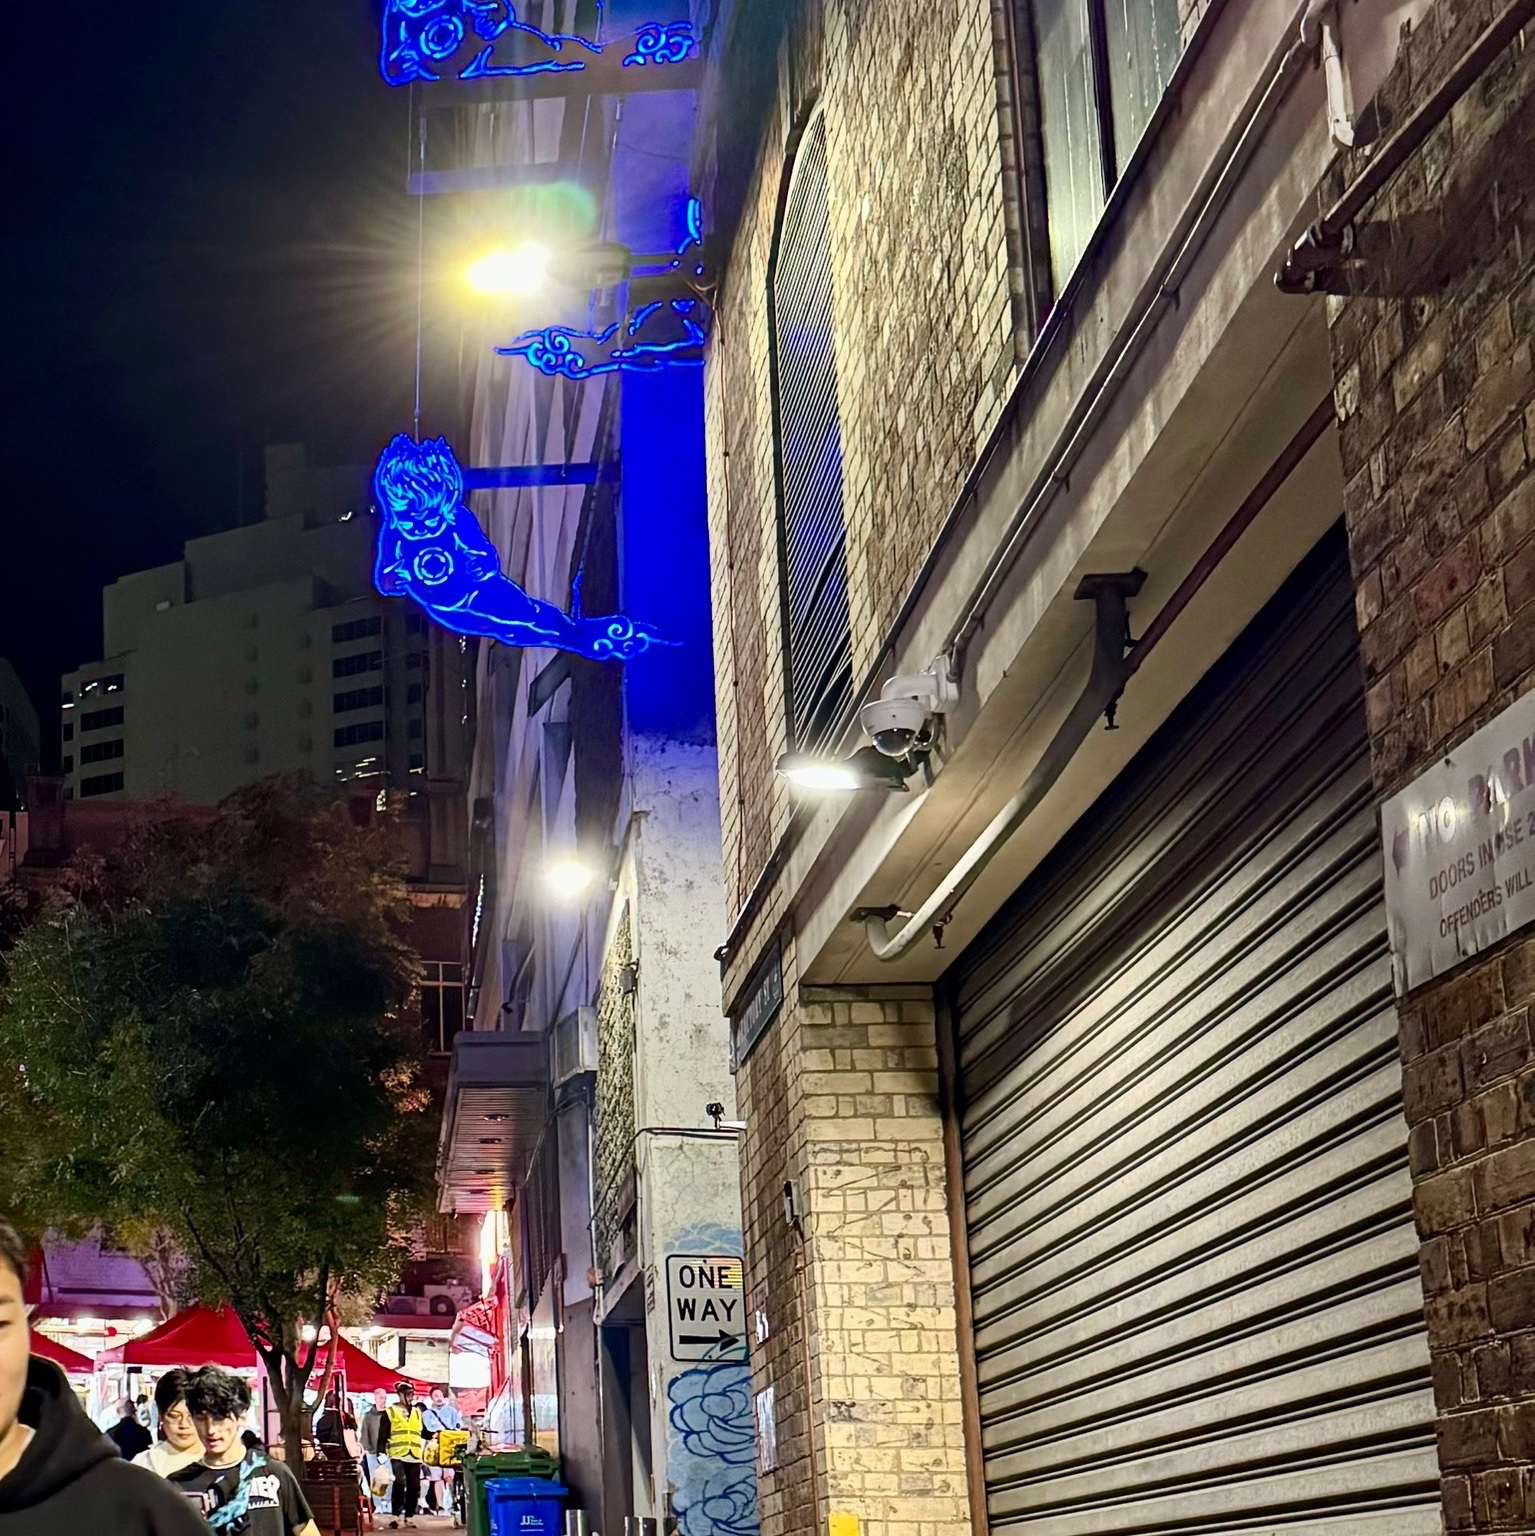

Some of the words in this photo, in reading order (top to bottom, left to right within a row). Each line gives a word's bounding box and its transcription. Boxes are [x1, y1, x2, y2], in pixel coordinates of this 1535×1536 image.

[1429, 852, 1475, 900] DOORS
[1439, 886, 1502, 938] OFFENDERS
[1504, 867, 1533, 898] WILL
[679, 1265, 732, 1288] ONE
[677, 1298, 737, 1322] WAY
